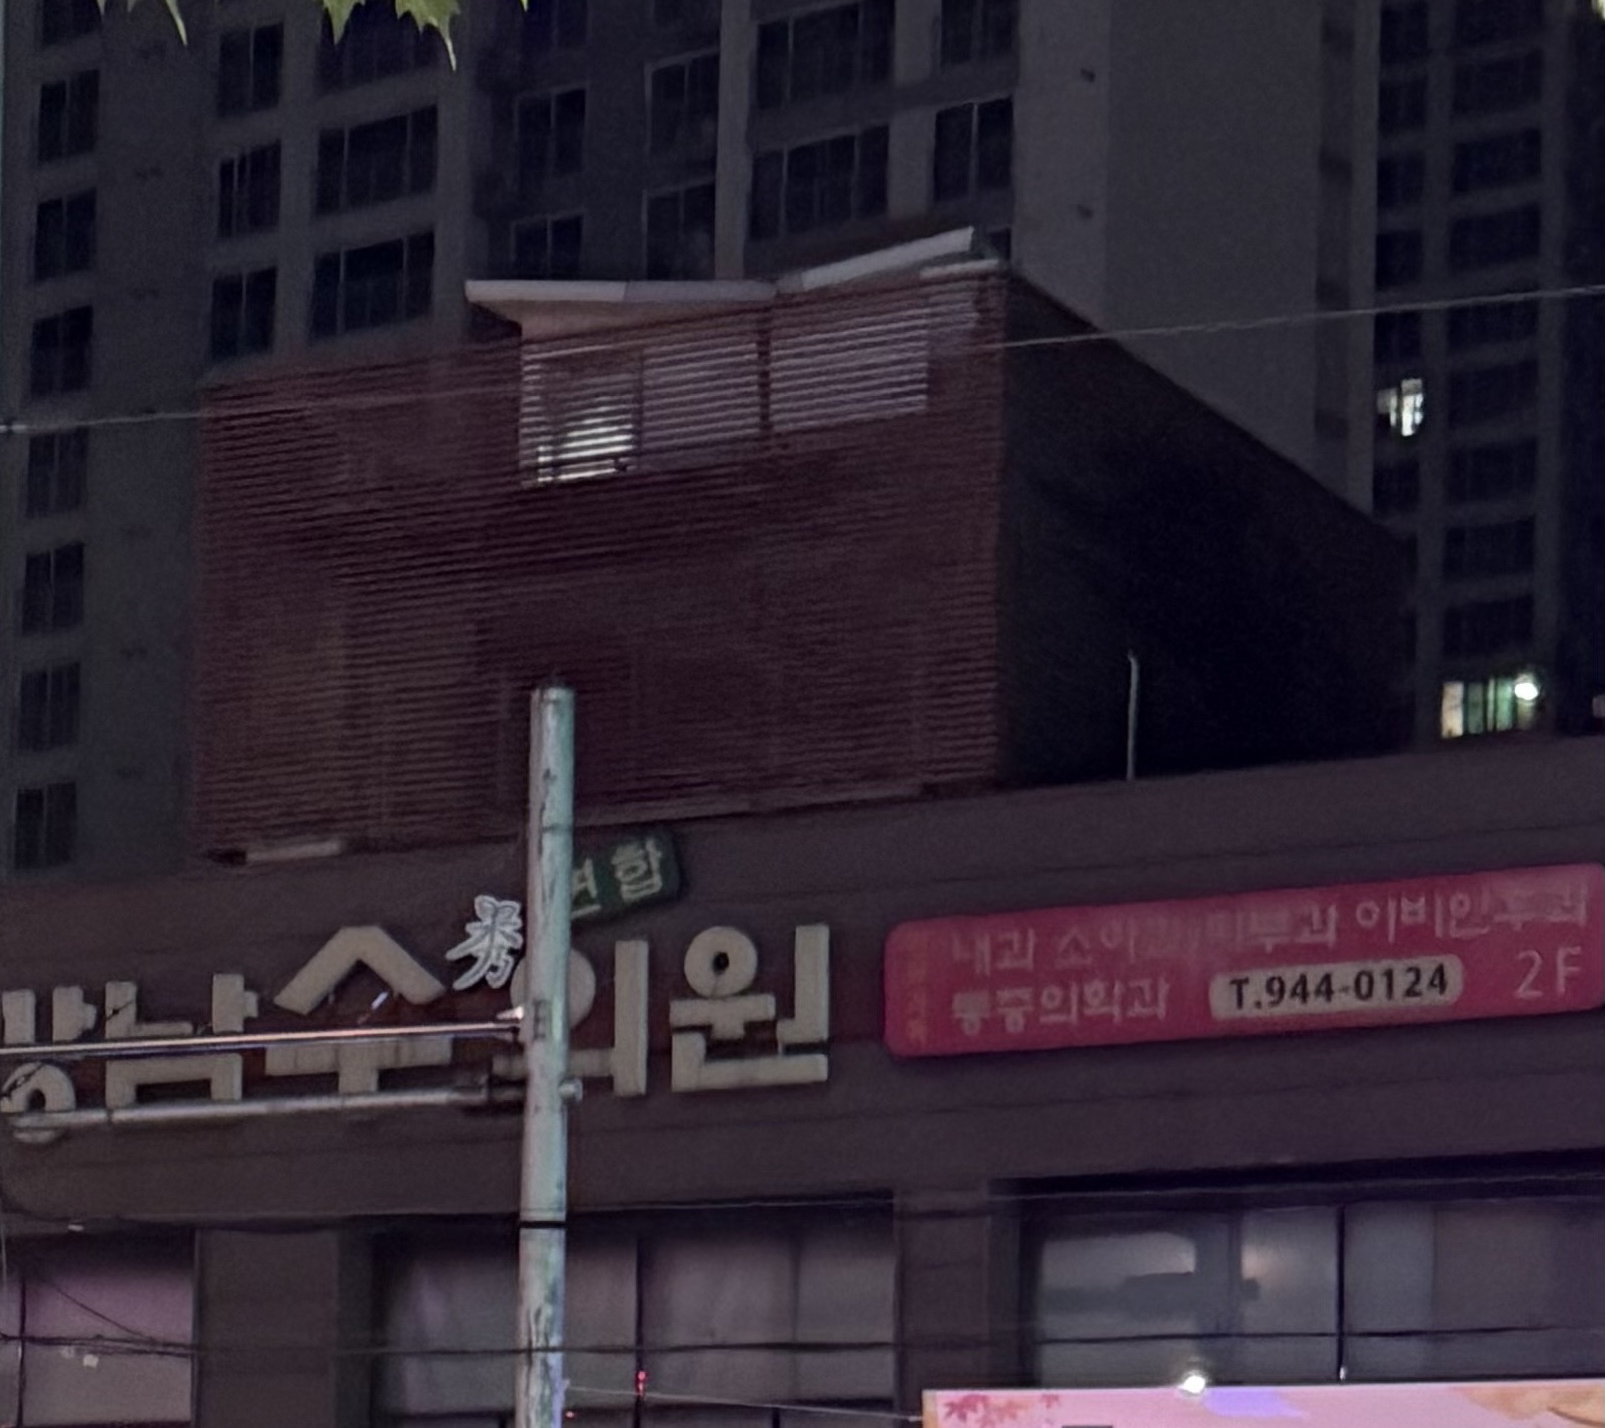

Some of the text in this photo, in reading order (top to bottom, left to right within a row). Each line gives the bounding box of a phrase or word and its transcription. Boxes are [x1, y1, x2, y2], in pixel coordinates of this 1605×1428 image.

[951, 928, 1036, 977] 내과
[1355, 880, 1587, 942] 이비인후과
[1230, 963, 1449, 1010] T.944-0124
